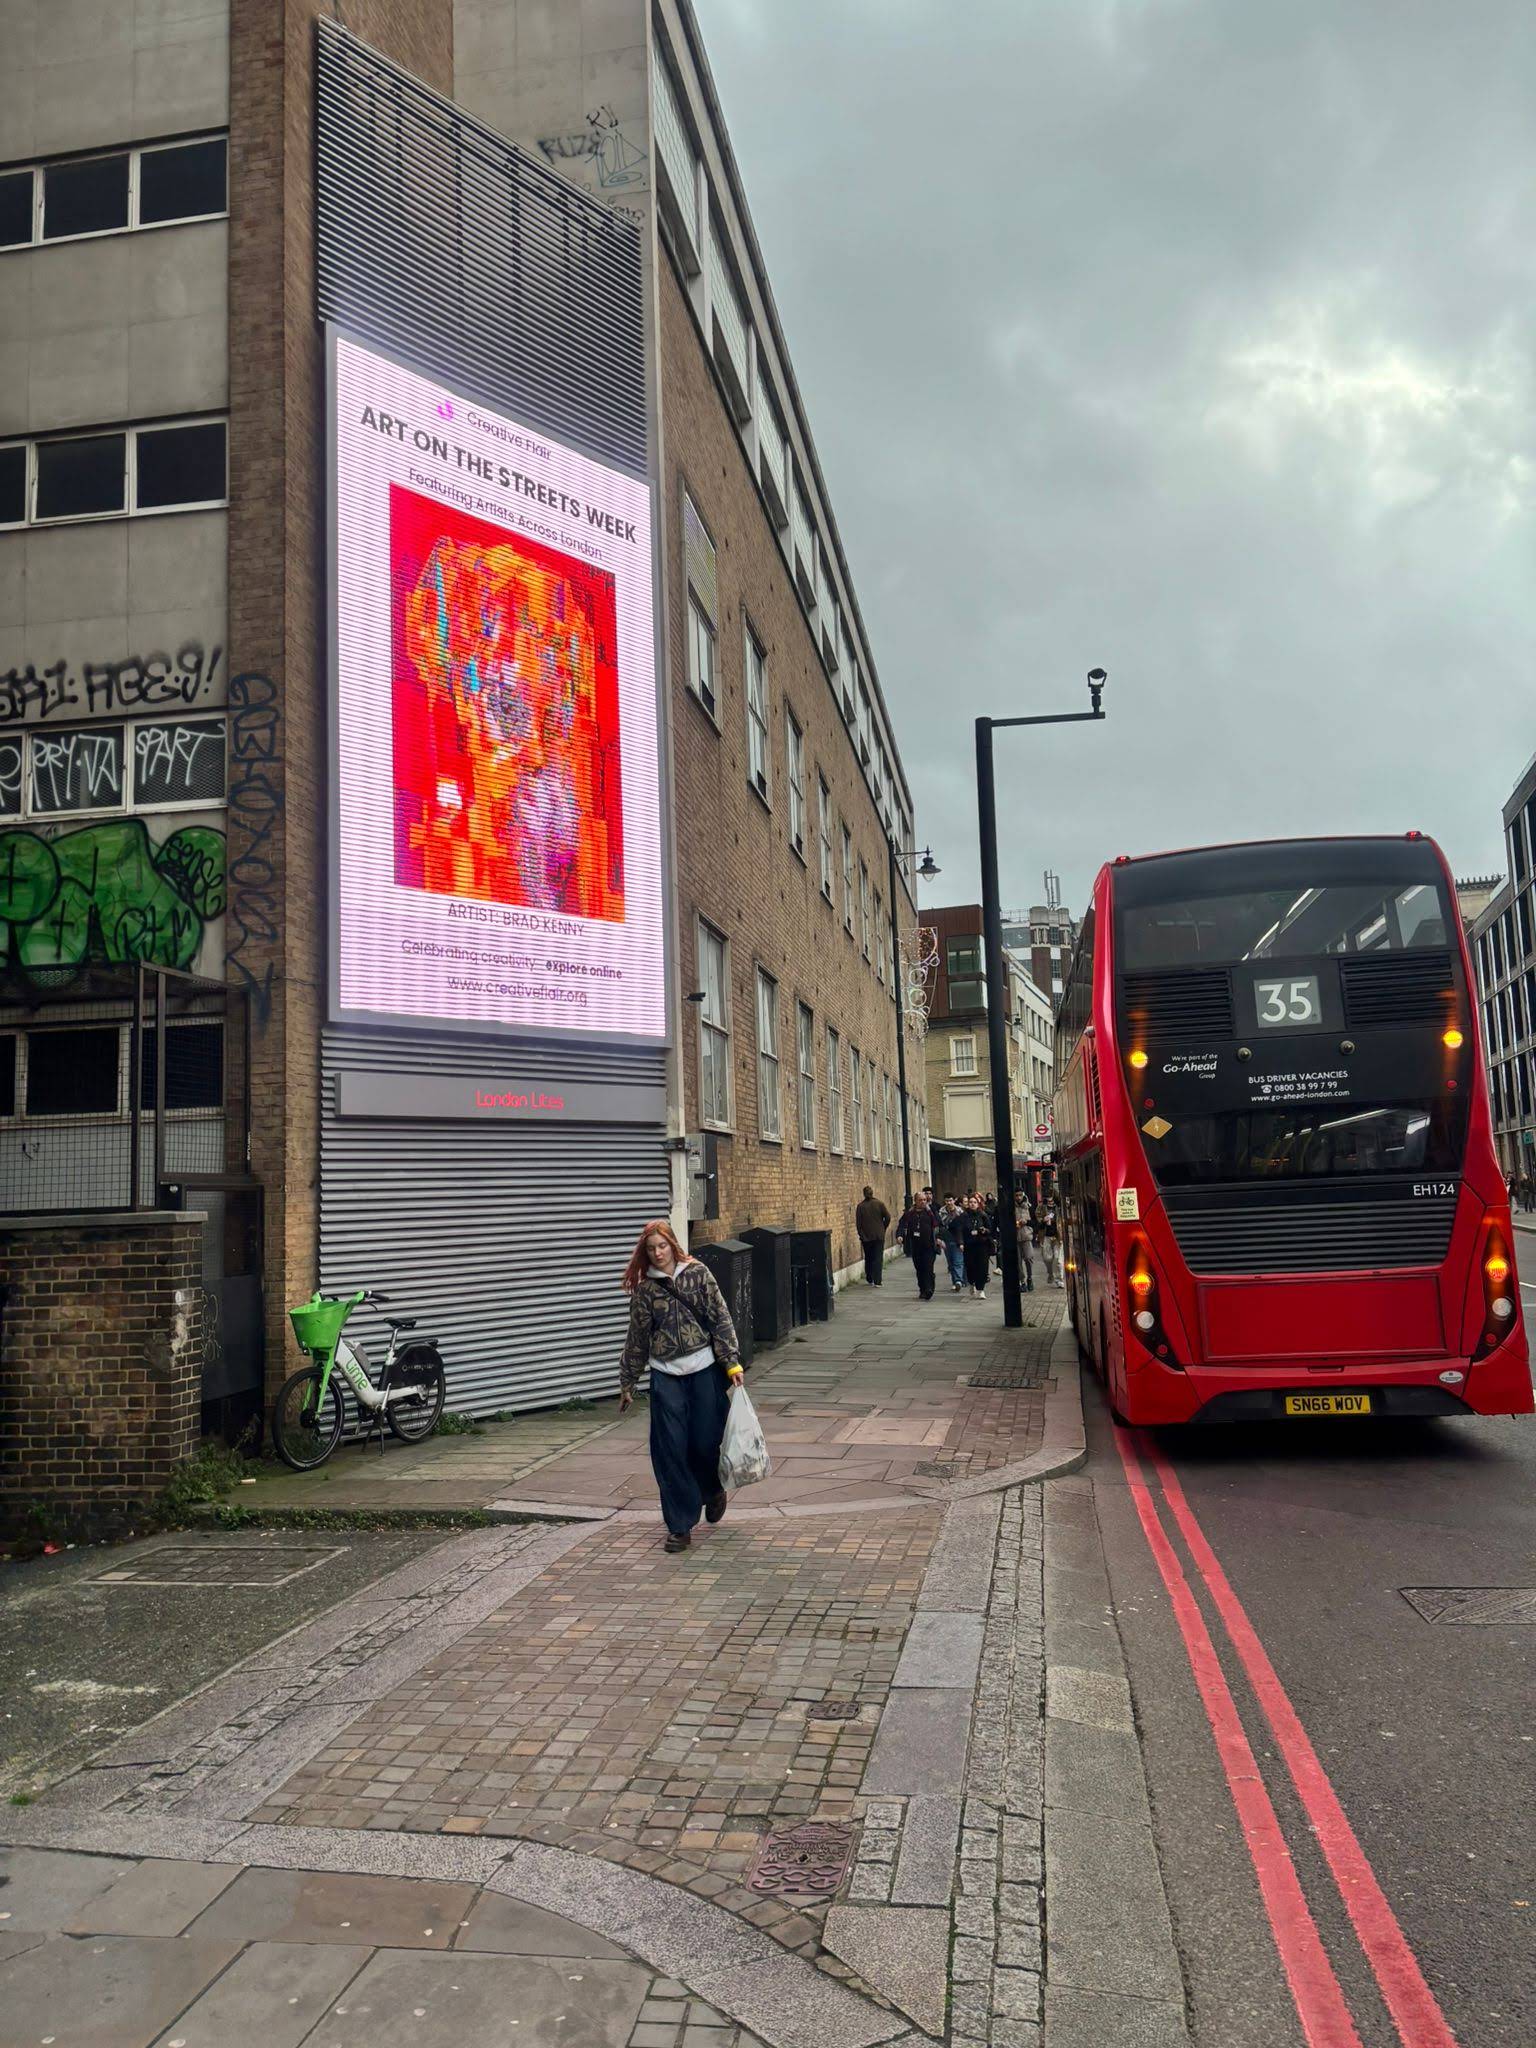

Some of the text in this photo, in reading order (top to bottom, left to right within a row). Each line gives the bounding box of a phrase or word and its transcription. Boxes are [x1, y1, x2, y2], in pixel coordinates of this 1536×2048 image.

[467, 410, 552, 461] Creative Flair
[360, 405, 637, 544] ART ON THE STREETS WEEK
[409, 468, 602, 558] Featuring Artists Across London
[448, 903, 585, 936] ARTIST: BRAD KENNY
[401, 939, 623, 979] Celebrating creativity explore online
[1257, 981, 1313, 1023] 35
[1163, 1061, 1217, 1073] Go-Ahead
[1248, 1070, 1349, 1084] BUS DRIVER VACANCIES
[1251, 1090, 1350, 1102] www.go-ahead-london.com
[1274, 1081, 1338, 1092] 0800 38 99 7 99
[475, 1089, 528, 1109] London
[1413, 1183, 1456, 1197] EH124
[1293, 1397, 1363, 1412] SN66 WOV
